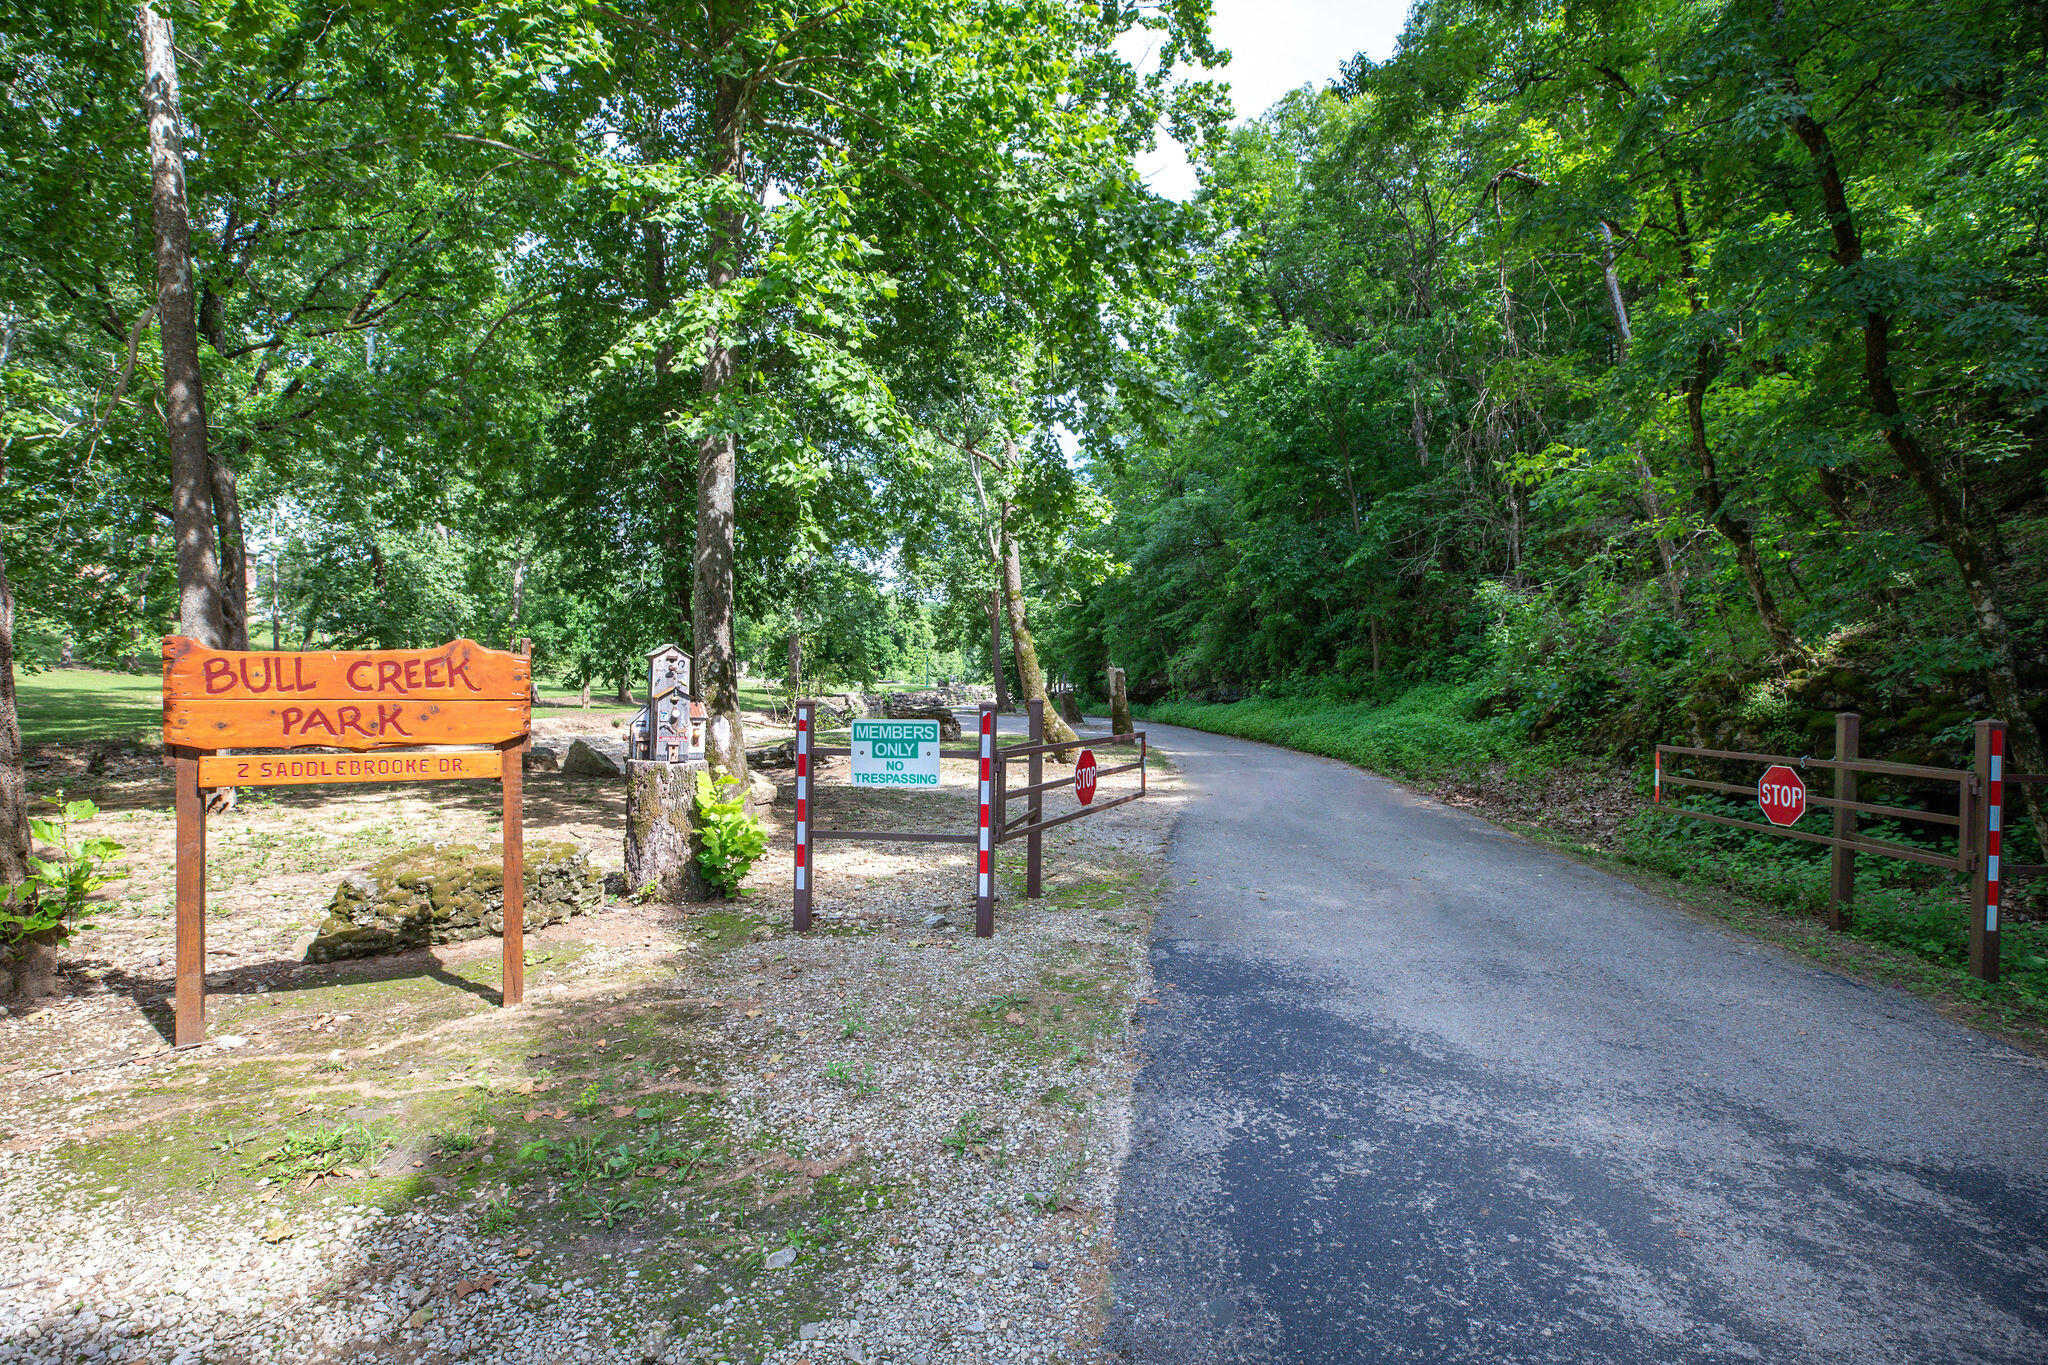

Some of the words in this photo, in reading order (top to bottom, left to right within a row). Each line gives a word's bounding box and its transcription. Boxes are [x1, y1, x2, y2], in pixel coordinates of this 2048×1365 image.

[202, 656, 316, 695] BULL
[347, 656, 481, 694] CREEK
[281, 704, 412, 737] PARK
[856, 725, 935, 739] MEMBERS
[875, 743, 915, 756] ONLY
[261, 759, 429, 778] SADDLEBROOKE
[439, 758, 470, 774] DR.
[886, 761, 904, 771] NO
[854, 773, 937, 785] TRESPASSING
[1076, 766, 1096, 791] STOP
[1761, 783, 1802, 808] STOP
